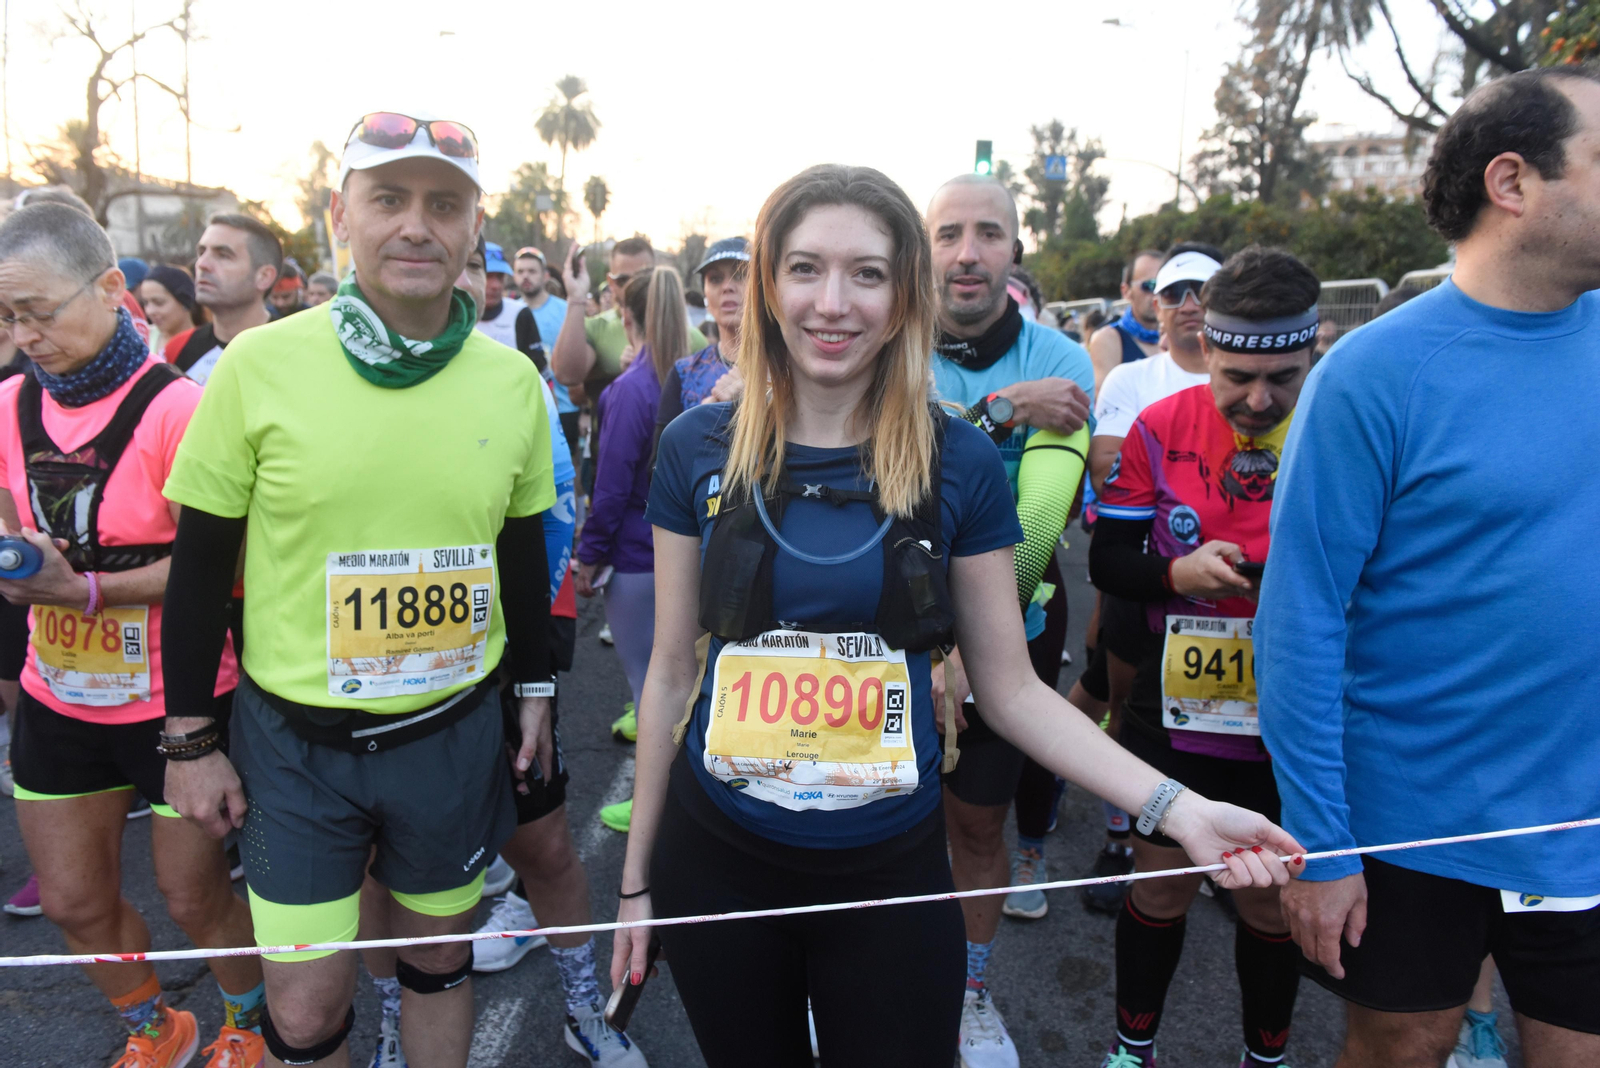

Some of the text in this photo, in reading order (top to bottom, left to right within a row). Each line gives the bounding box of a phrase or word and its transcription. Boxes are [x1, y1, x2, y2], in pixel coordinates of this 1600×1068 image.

[338, 550, 410, 568] MEDIO MARATÓN
[433, 547, 475, 569] SEVILLA
[344, 582, 470, 631] 11888
[37, 606, 122, 653] 10978
[386, 632, 404, 640] Alba
[761, 633, 809, 649] MARATÓN
[402, 677, 427, 686] HOKA
[716, 693, 727, 718] CAJÓN
[731, 671, 884, 731] 10890
[790, 728, 818, 739] Marie
[786, 750, 819, 760] Lerouge
[793, 790, 823, 801] HOKA
